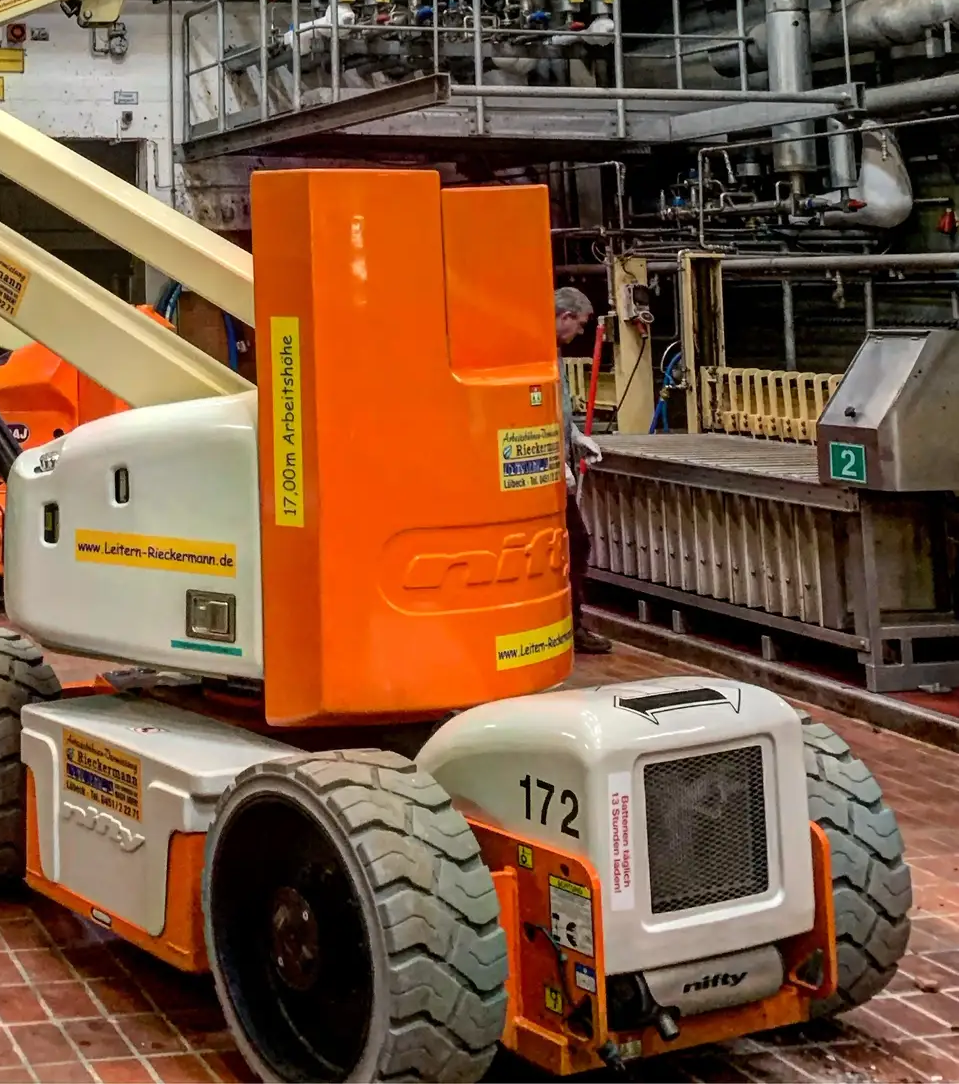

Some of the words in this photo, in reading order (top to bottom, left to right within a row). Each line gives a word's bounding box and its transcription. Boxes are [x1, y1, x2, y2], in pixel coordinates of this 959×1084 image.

[280, 334, 295, 445] Arbeitshöhe
[841, 449, 858, 477] 2
[77, 541, 234, 567] www.Leitern-Rieckermann.de
[77, 749, 138, 787] Rieckermann
[519, 774, 580, 840] 172
[611, 791, 620, 805] 13
[63, 801, 146, 854] nifty
[611, 809, 620, 857] Stunden
[613, 858, 622, 894] laden!
[622, 849, 631, 888] täglich
[682, 971, 749, 994] nifty
